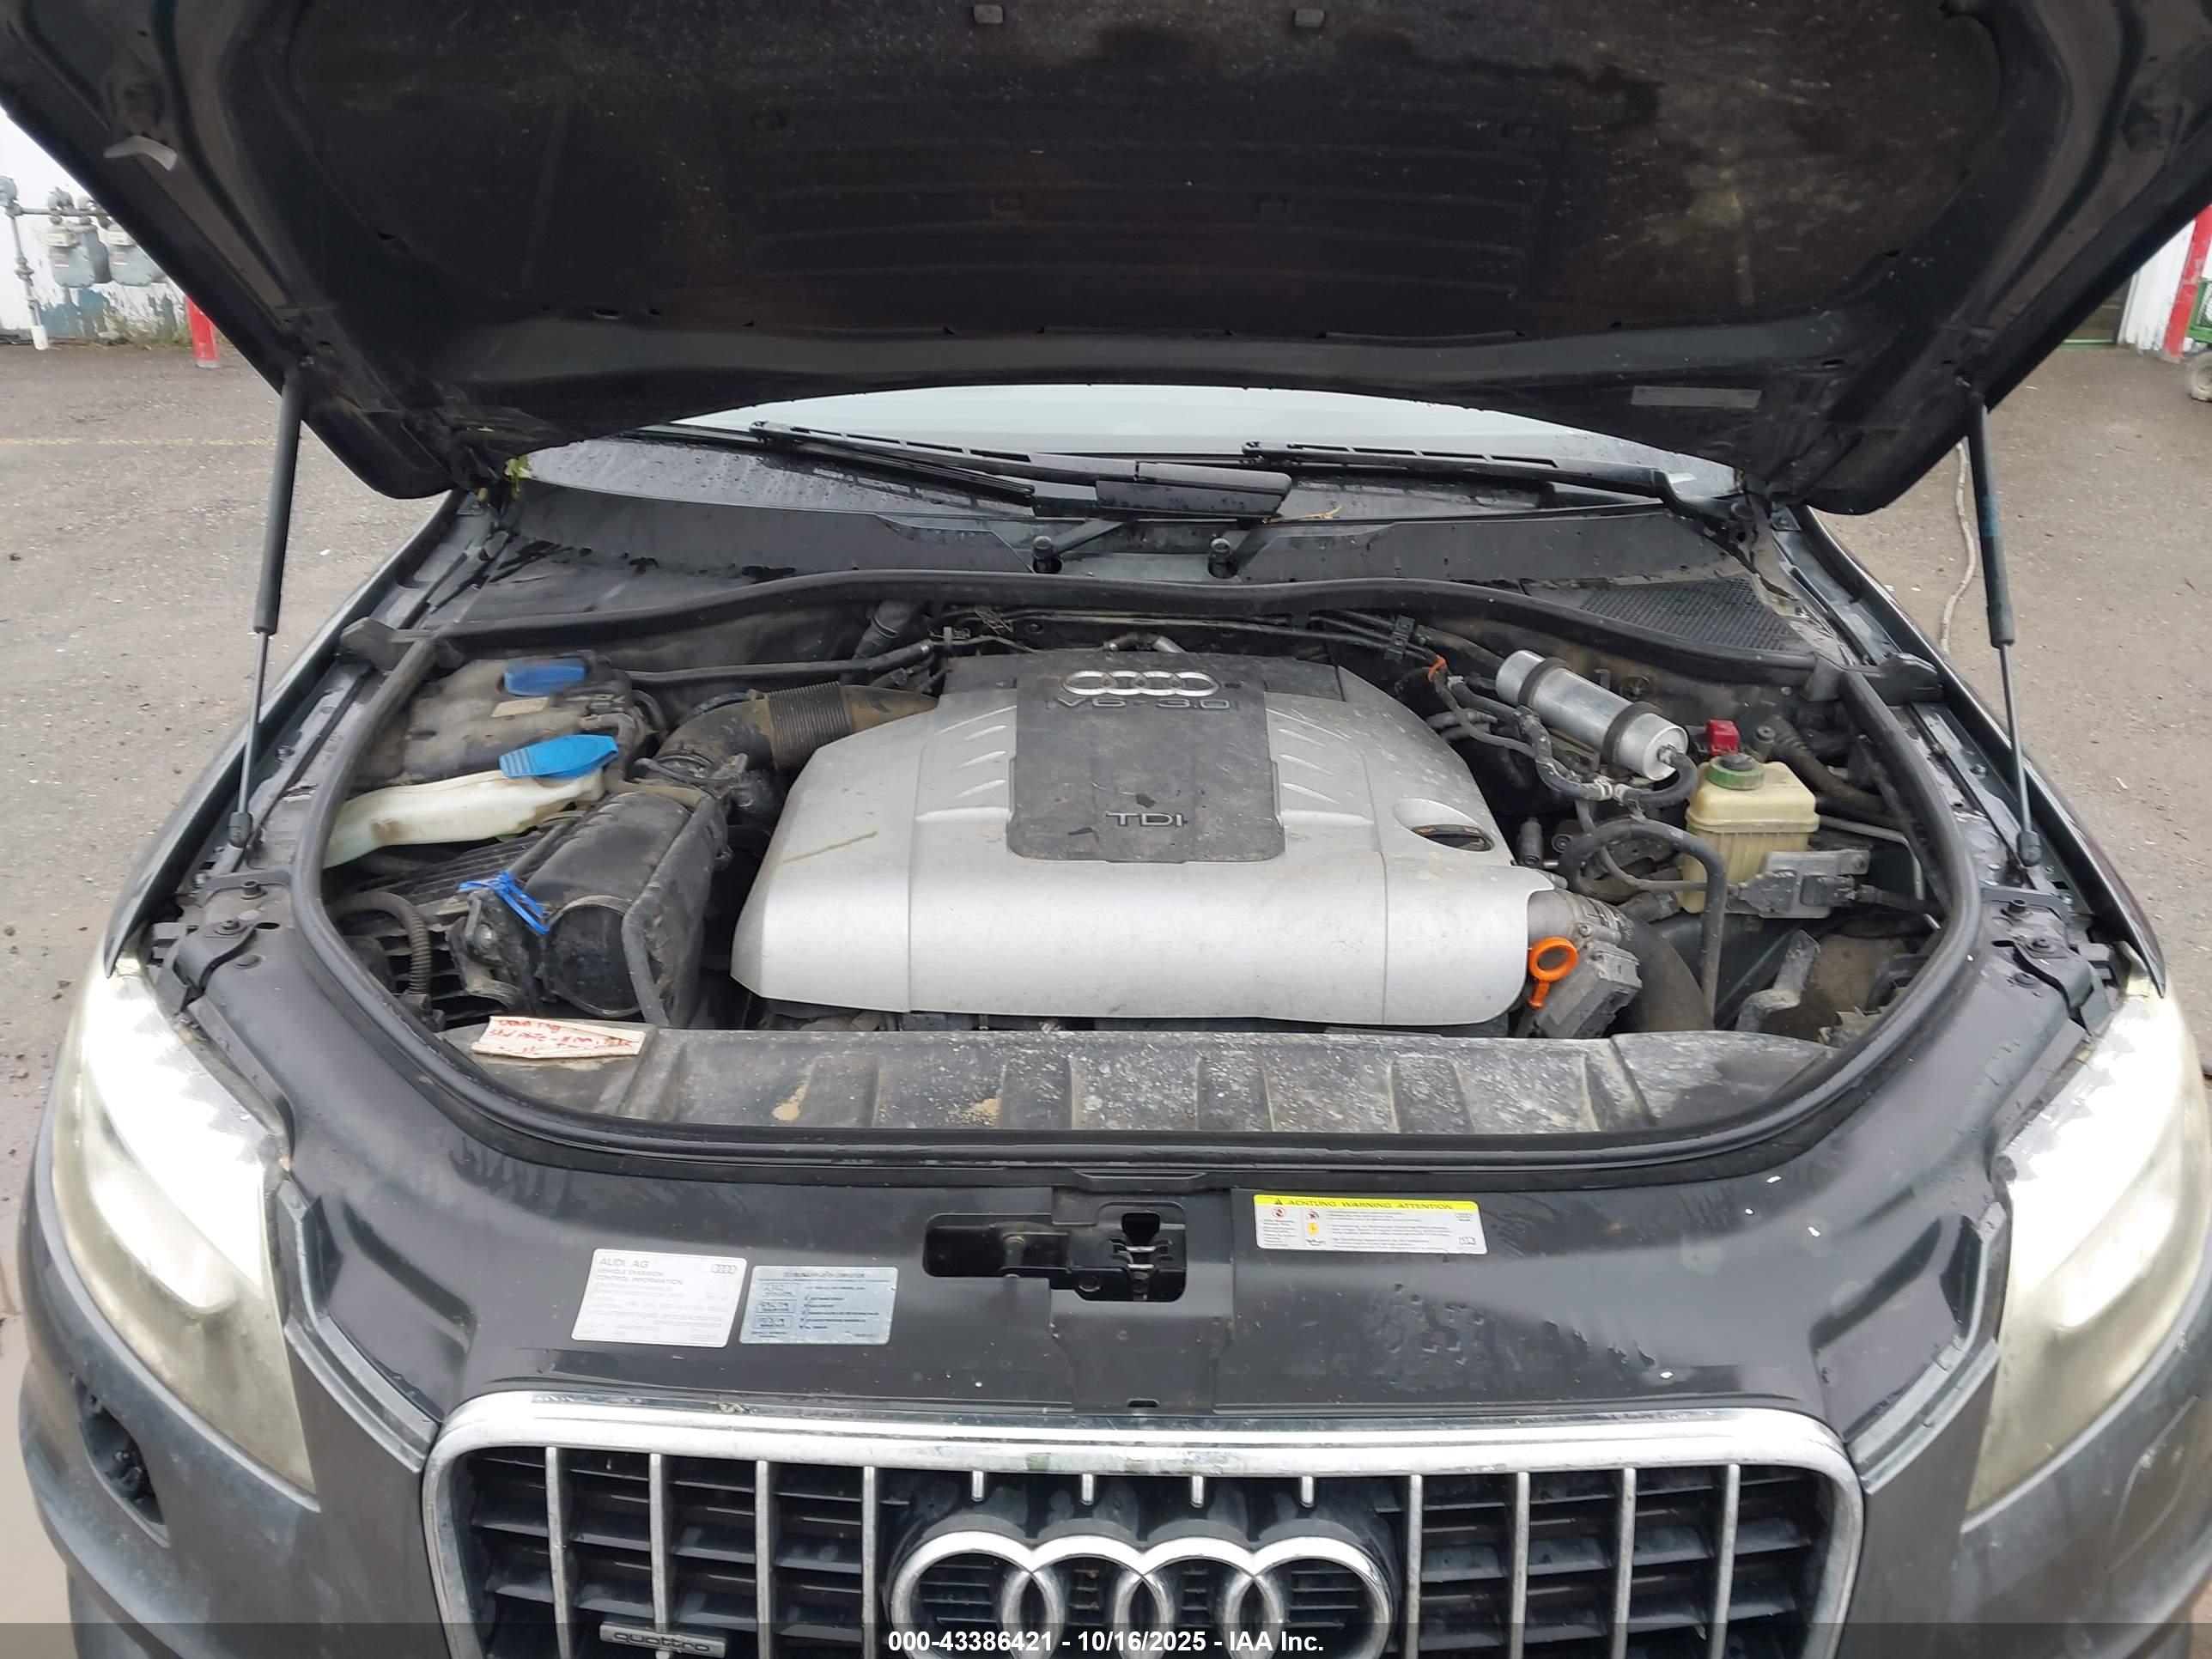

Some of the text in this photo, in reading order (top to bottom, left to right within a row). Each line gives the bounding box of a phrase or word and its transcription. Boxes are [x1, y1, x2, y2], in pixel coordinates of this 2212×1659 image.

[1055, 697, 1127, 708] V6
[1156, 698, 1231, 709] 3.0
[1105, 812, 1183, 827] TDI
[599, 1258, 649, 1268] AUDI AG
[614, 1632, 710, 1652] quattro
